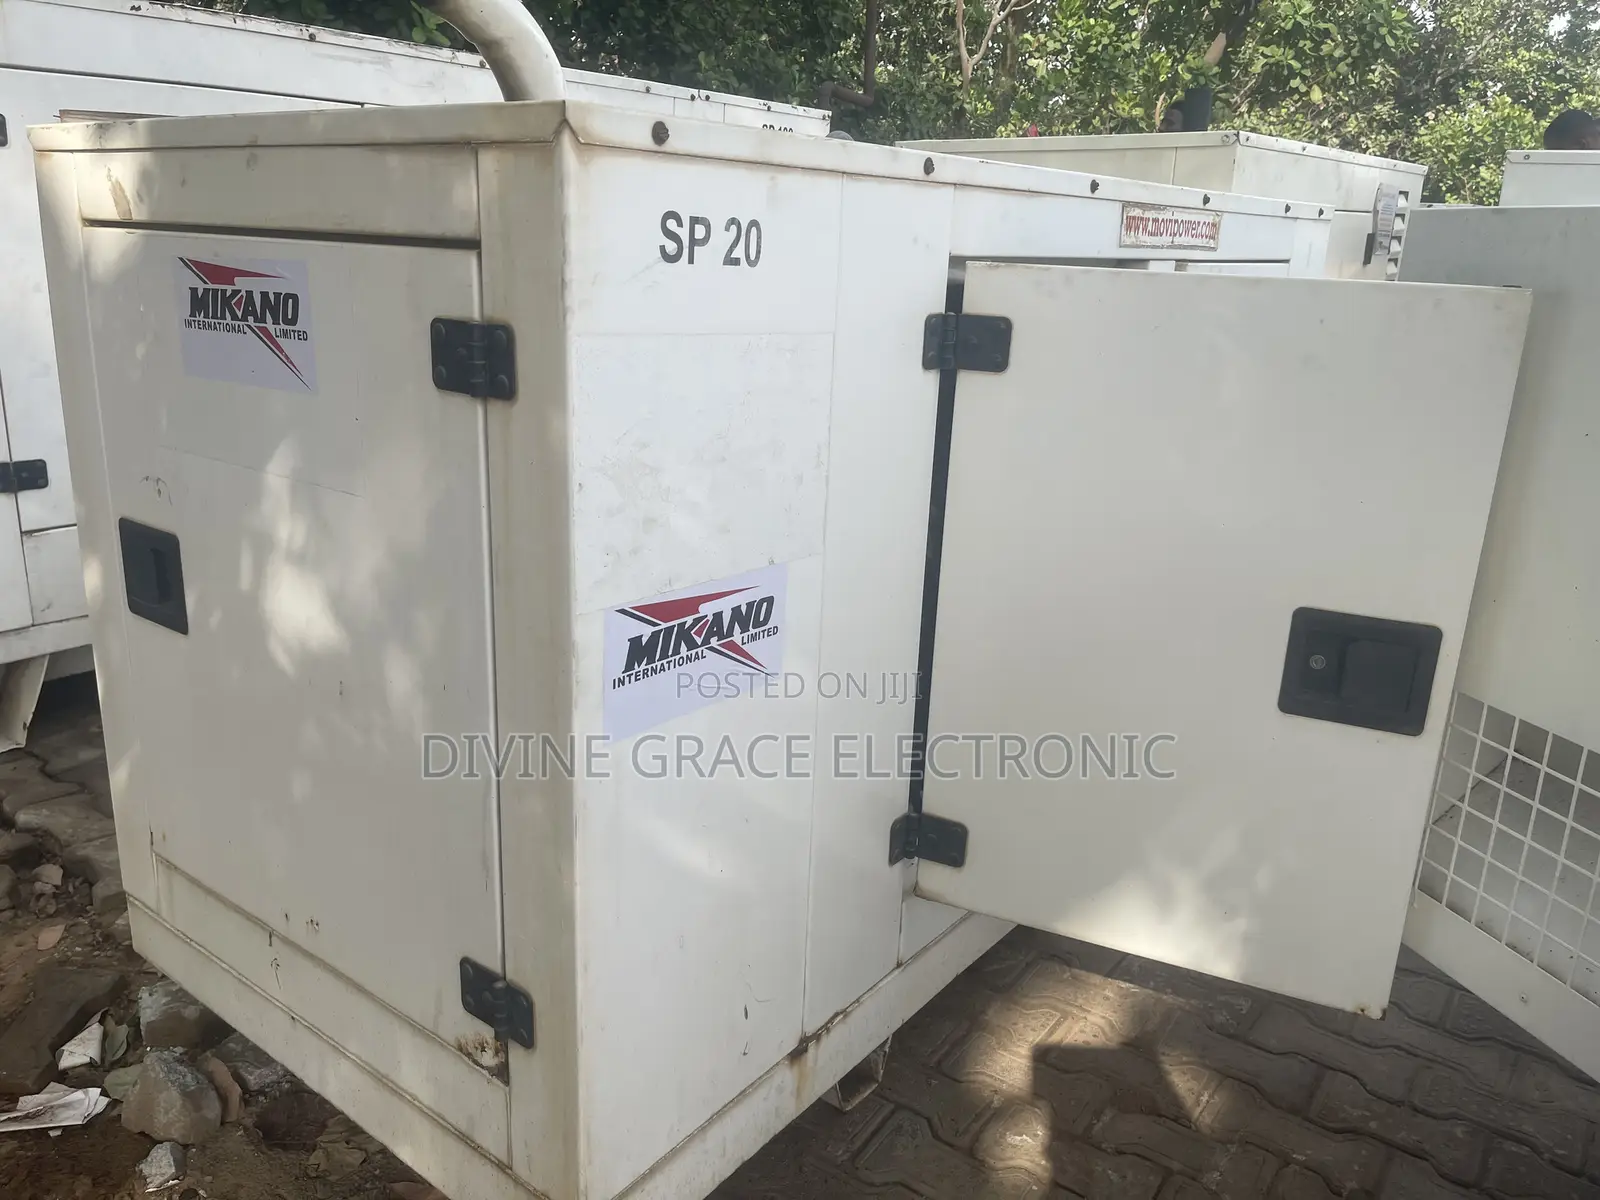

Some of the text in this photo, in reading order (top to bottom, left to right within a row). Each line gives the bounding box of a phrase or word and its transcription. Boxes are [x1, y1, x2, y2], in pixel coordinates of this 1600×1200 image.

[659, 210, 762, 268] SP 20
[1125, 214, 1218, 242] www.movipower.com
[184, 318, 308, 341] INTERNATIONAL LIMITED
[189, 287, 299, 326] MIKANO
[612, 625, 779, 690] INTERNATIONAL LIMITED
[622, 595, 775, 674] MIKANO
